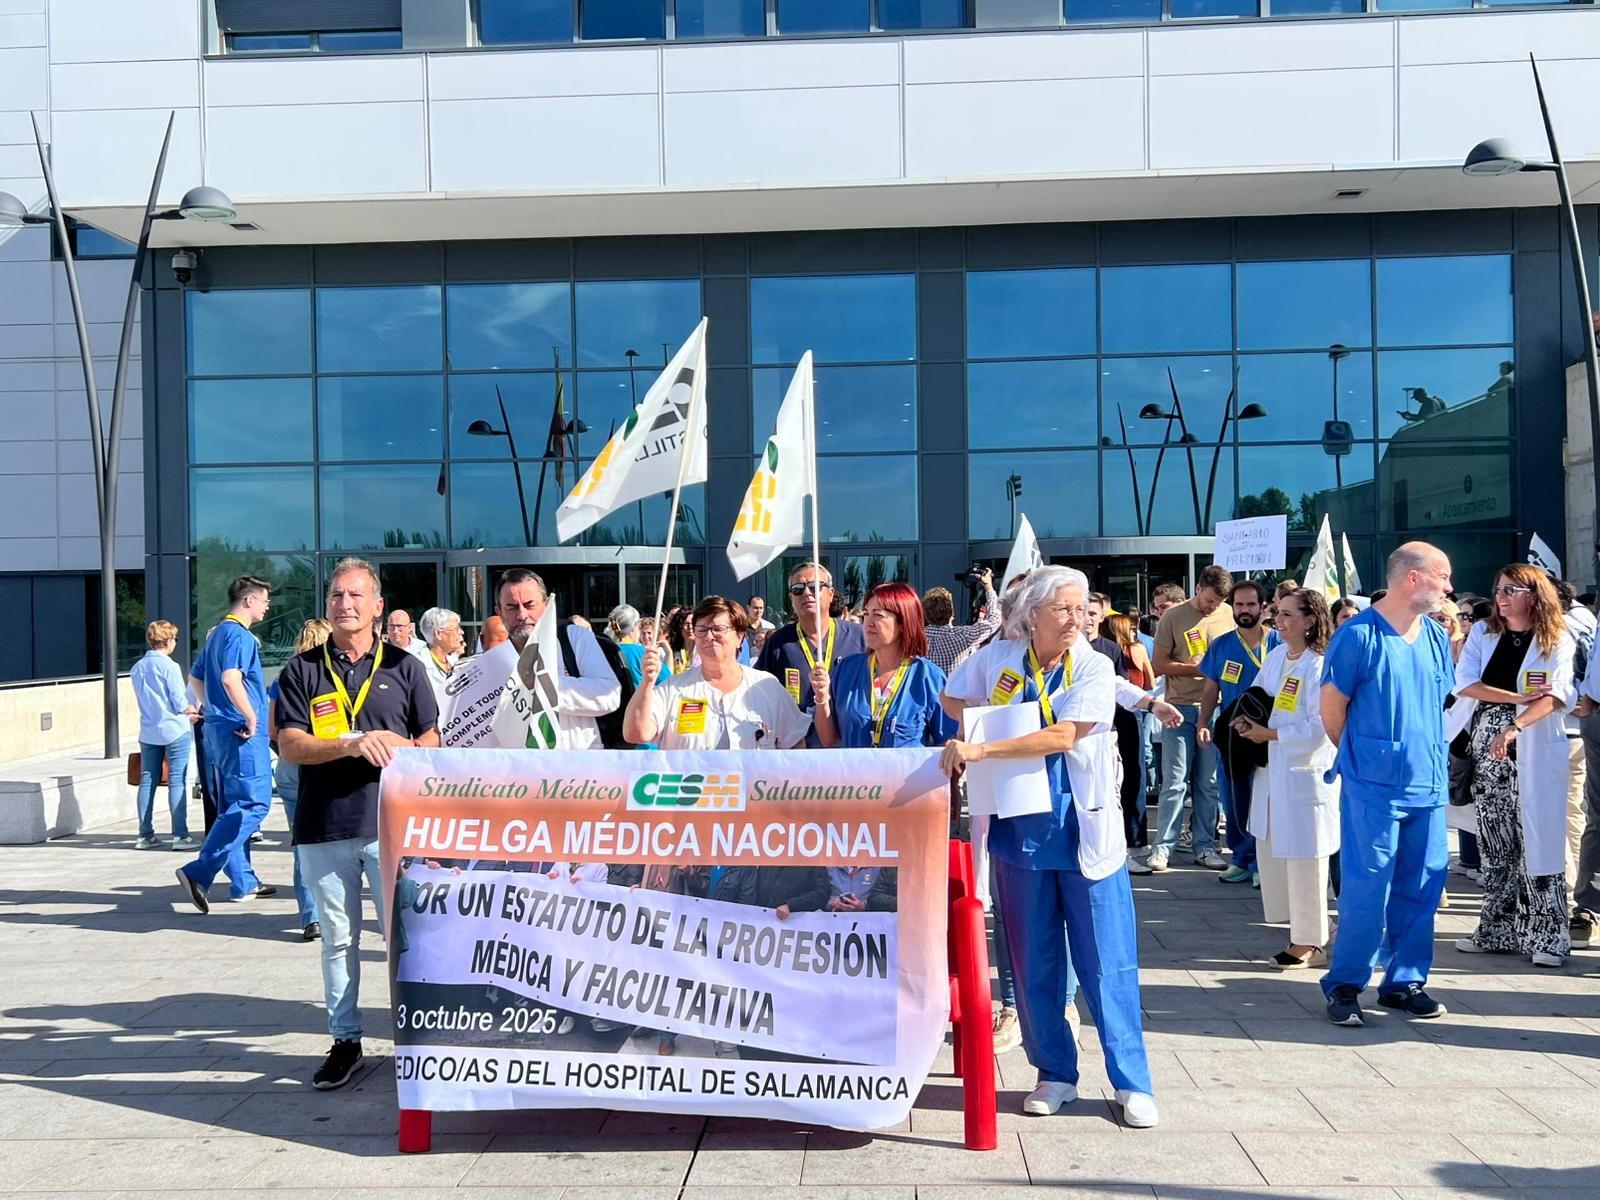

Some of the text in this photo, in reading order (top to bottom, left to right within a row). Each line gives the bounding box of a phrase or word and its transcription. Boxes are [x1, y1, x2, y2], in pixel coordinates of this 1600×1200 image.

[445, 705, 498, 748] COMPLEME
[462, 705, 477, 719] DE
[418, 776, 623, 801] Sindicato Médico
[632, 772, 740, 808] CESM
[750, 779, 882, 801] Salamanca
[403, 812, 899, 858] HUELGA MÉDICA NACIONAL
[457, 882, 496, 917] UN
[501, 884, 627, 942] ESTATUTO
[631, 906, 671, 949] DE
[673, 914, 708, 957] LA
[717, 921, 888, 979] PROFESIÓN
[470, 932, 774, 1036] MÉDICA Y FACULTATIVA
[396, 1004, 557, 1034] 3 octubre 2025
[506, 1059, 556, 1086] DEL
[565, 1062, 692, 1093] HOSPITAL
[701, 1068, 735, 1095] DE
[744, 1070, 909, 1100] SALAMANCA
